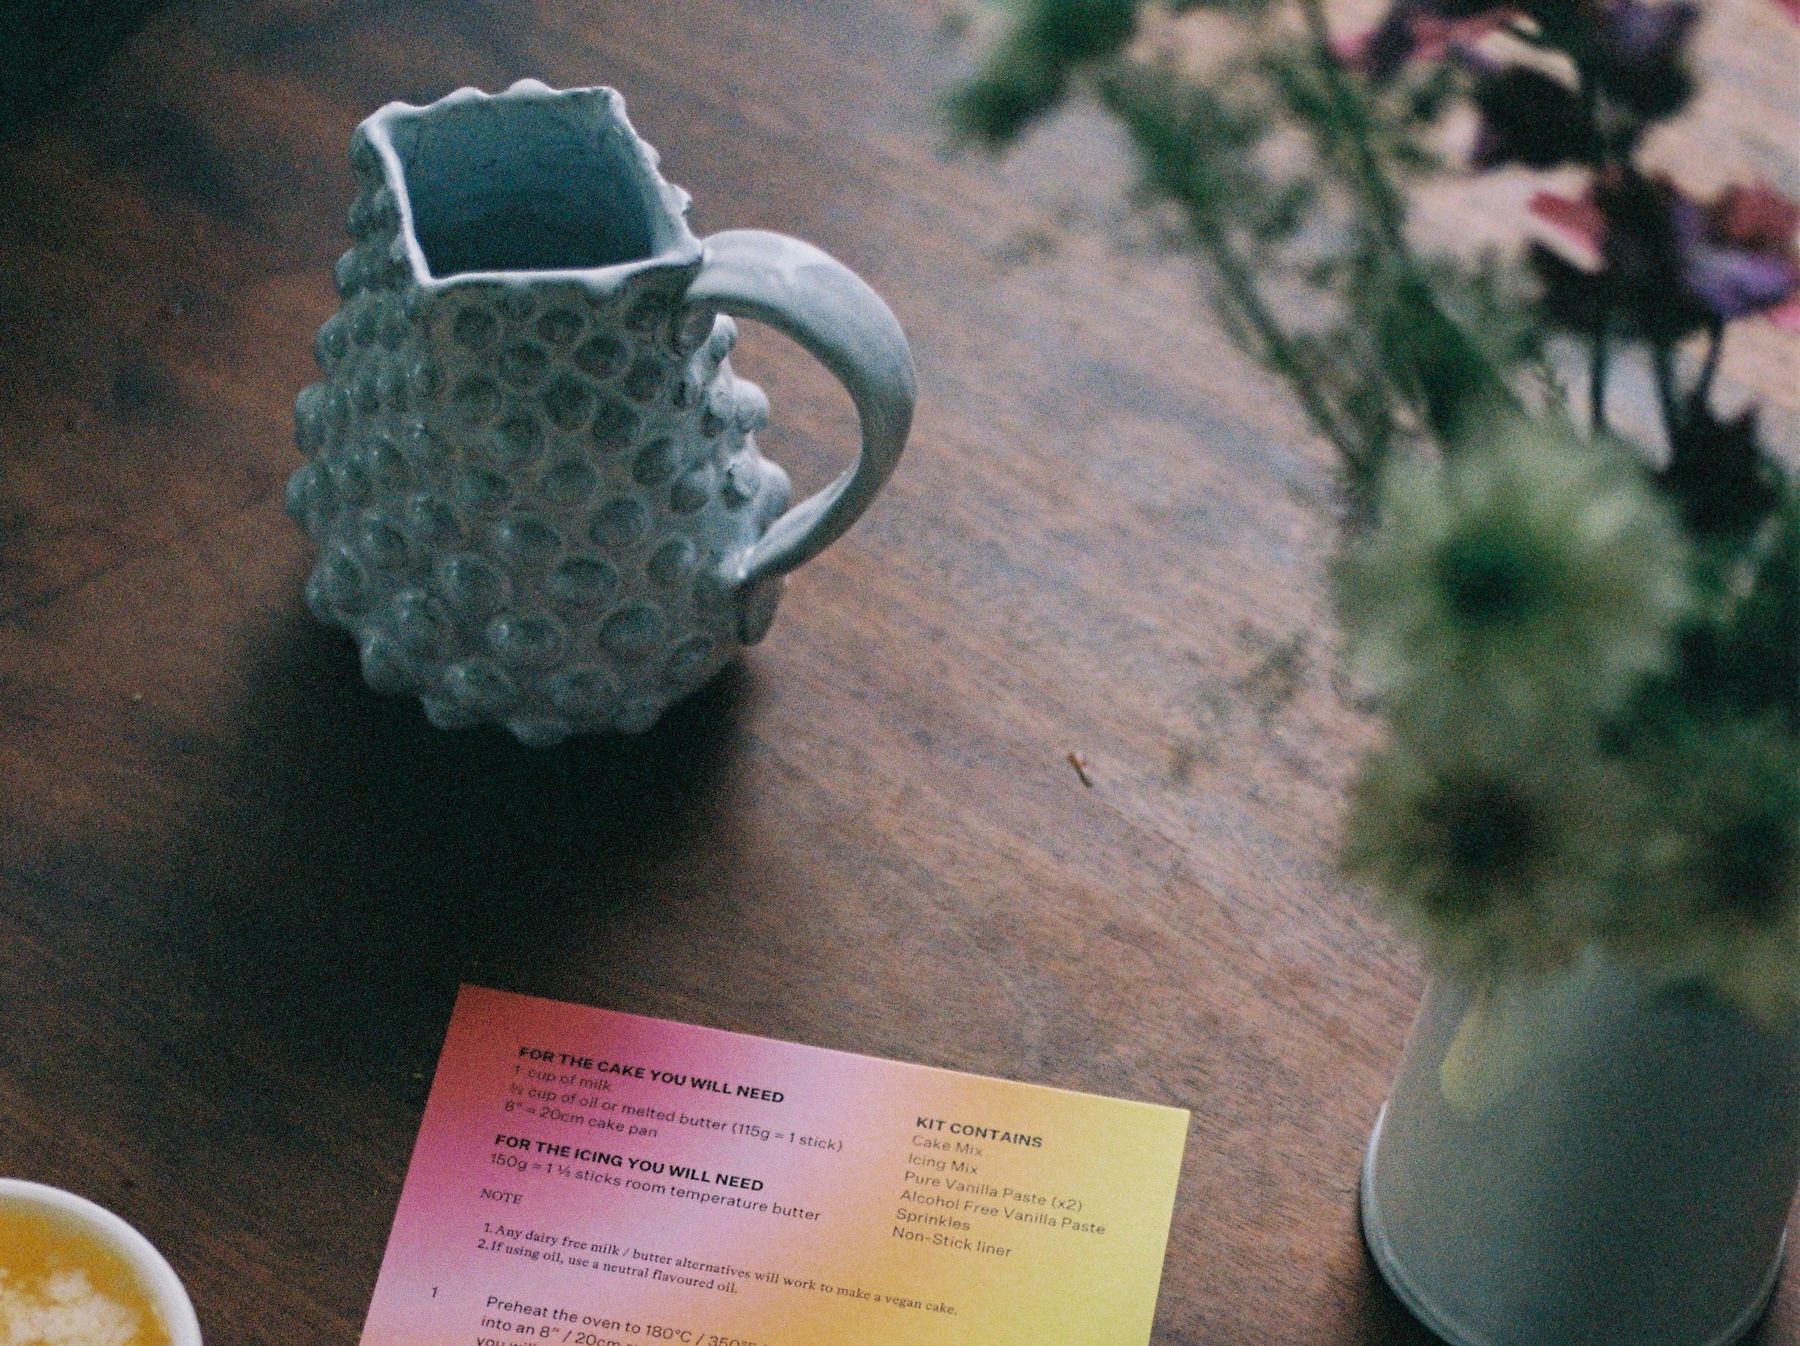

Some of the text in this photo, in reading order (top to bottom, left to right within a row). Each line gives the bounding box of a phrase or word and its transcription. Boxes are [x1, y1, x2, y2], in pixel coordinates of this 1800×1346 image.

[519, 1046, 785, 1104] FOR THE CAKE YOU WILL NEED
[528, 1088, 557, 1102] cup
[561, 1093, 577, 1103] of
[579, 1097, 599, 1108] oil
[601, 1101, 618, 1111] or
[621, 1104, 676, 1123] melted
[678, 1113, 728, 1131] butter
[731, 1122, 771, 1142] (115g
[799, 1136, 844, 1153] stick)
[539, 1106, 658, 1138] 20cm cake pan
[916, 1116, 1043, 1148] KIT CONTAINS
[494, 1134, 764, 1192] FOR THE ICING YOU WILL NEED
[908, 1153, 978, 1174] Icing Mix
[911, 1134, 982, 1157] Cake Mix
[479, 1187, 523, 1205] NOTE
[491, 1153, 821, 1221] 150g sticks room temperature butter
[903, 1170, 1084, 1213] Pure Vanilla Paste (x2)
[896, 1207, 971, 1231] Sprinkles
[899, 1189, 1106, 1235] Alcohol Free Vanilla Paste
[891, 1225, 1012, 1257] Non-Stick liner
[505, 1245, 540, 1261] using
[568, 1257, 589, 1268] use
[592, 1261, 600, 1270] a
[602, 1263, 650, 1278] neutral
[652, 1269, 715, 1290] flavoured
[524, 1230, 957, 1315] dairy free milk butter alternatives will work to make a vegan cake.
[431, 1285, 439, 1299] 1
[480, 1317, 512, 1332] into
[515, 1324, 536, 1335] an
[485, 1295, 549, 1318] Preheat
[552, 1308, 579, 1323] the
[581, 1315, 622, 1331] oven
[624, 1321, 642, 1335] to
